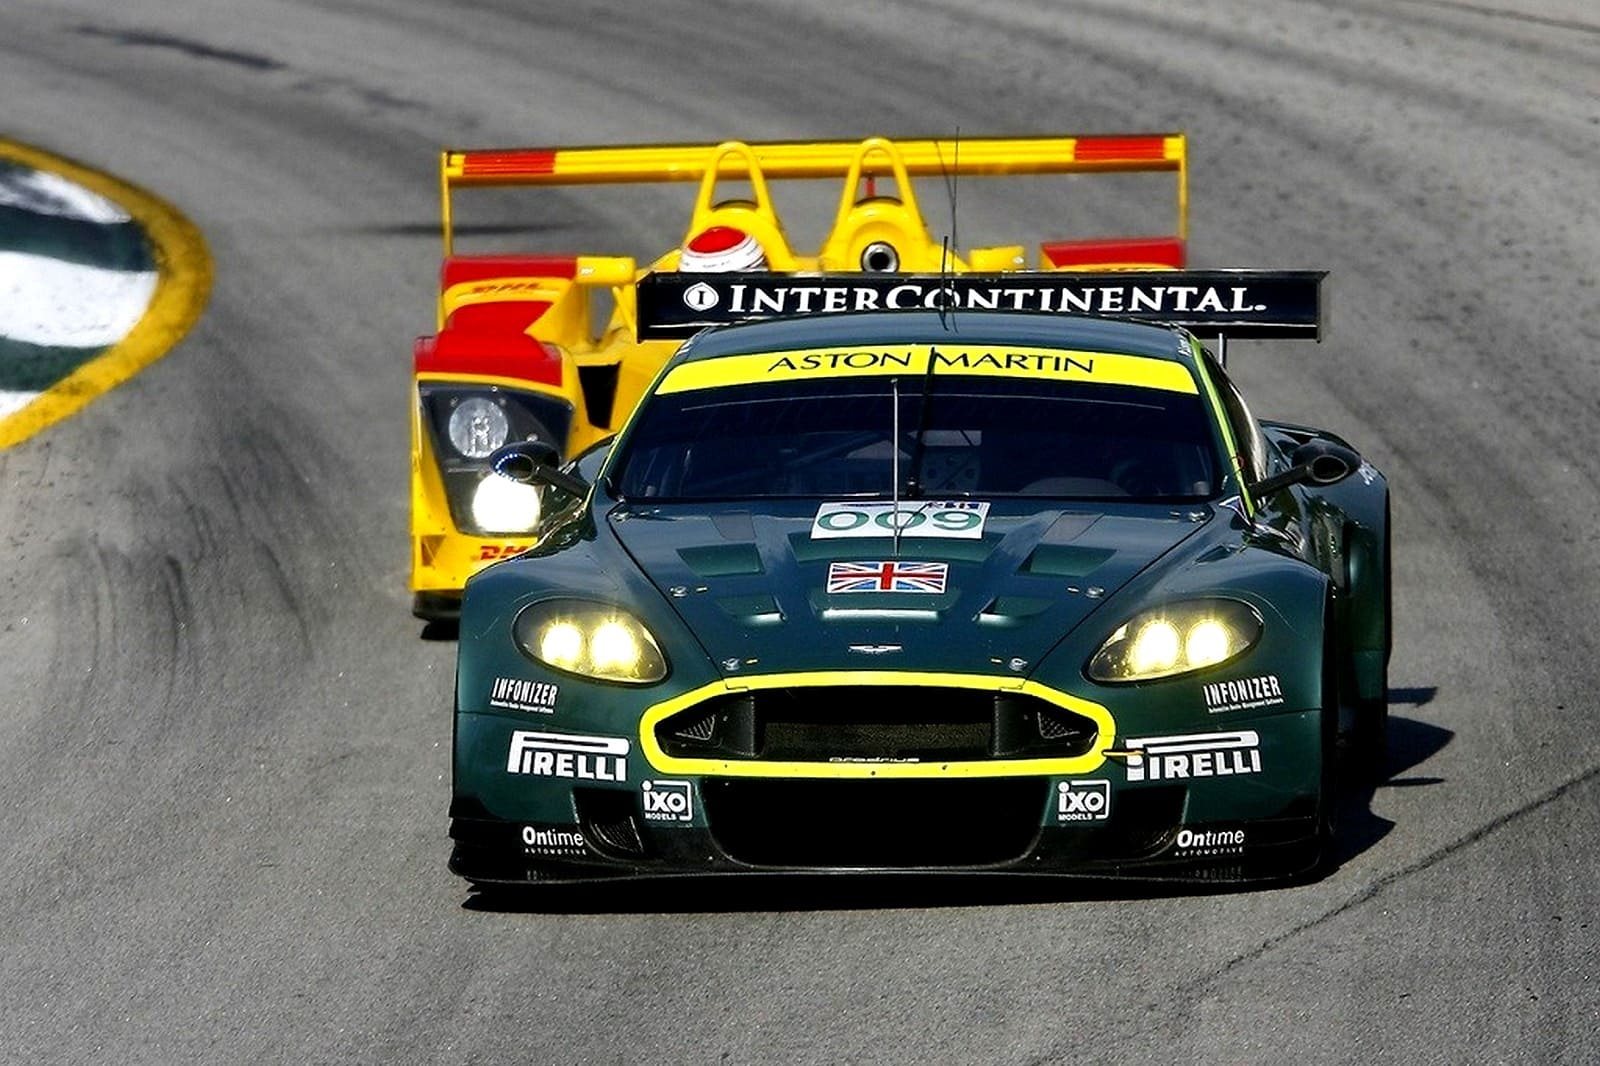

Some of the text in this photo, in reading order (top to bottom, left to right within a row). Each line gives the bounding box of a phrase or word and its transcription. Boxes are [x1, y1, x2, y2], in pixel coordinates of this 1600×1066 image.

[768, 351, 1093, 373] ASTON MARTIN
[817, 510, 982, 531] 009
[480, 545, 529, 560] DH
[492, 677, 559, 706] INFONIZER
[1203, 675, 1282, 706] INFONIZER
[507, 730, 630, 782] PIRELLI
[1125, 730, 1262, 781] PIRELLI
[645, 812, 677, 821] MODELS
[1058, 813, 1093, 821] MODELS
[522, 826, 584, 847] Ontime
[1177, 830, 1245, 848] Ontime
